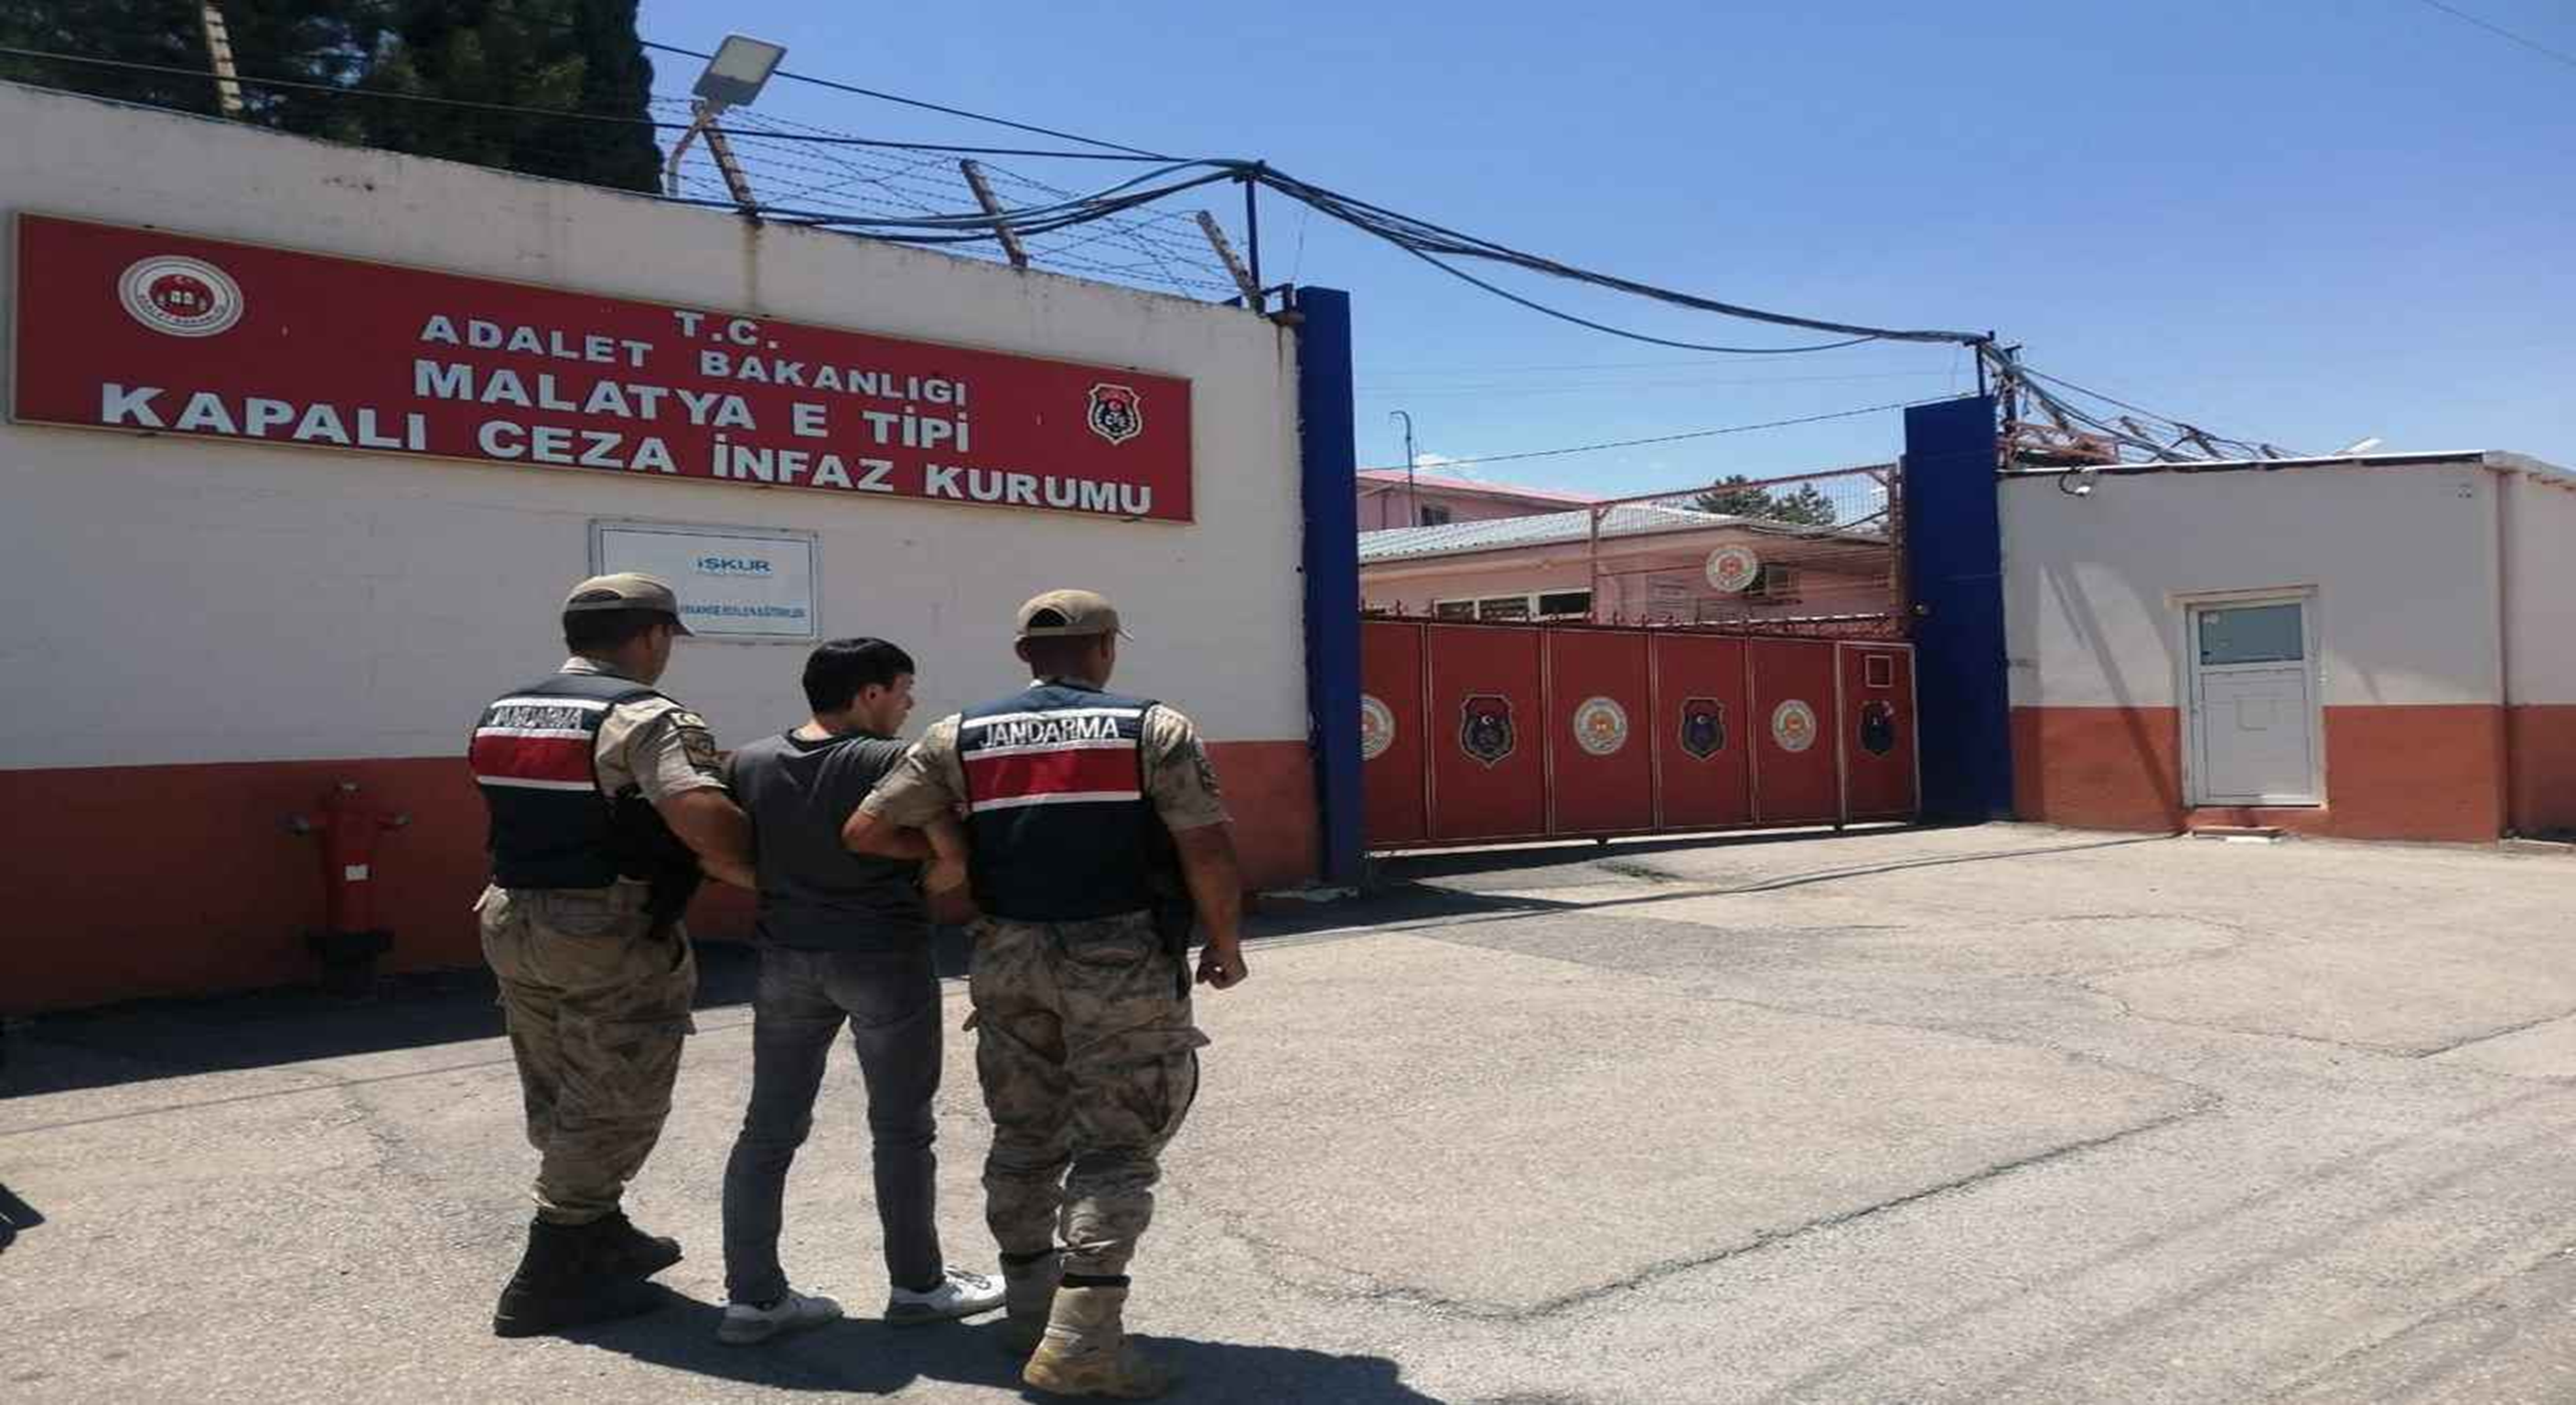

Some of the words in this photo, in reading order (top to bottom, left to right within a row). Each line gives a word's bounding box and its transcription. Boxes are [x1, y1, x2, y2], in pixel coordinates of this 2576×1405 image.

[421, 315, 653, 367] ADALET
[674, 311, 778, 349] T.C.
[415, 359, 757, 430] MALATYA
[793, 402, 828, 437] E
[863, 405, 970, 452] TİPİ
[102, 382, 426, 450] KAPALI
[478, 420, 676, 472] CEZA
[714, 434, 895, 492] İNFAZ
[926, 464, 1152, 515] KURUMU
[980, 716, 1121, 748] JANDARMA
